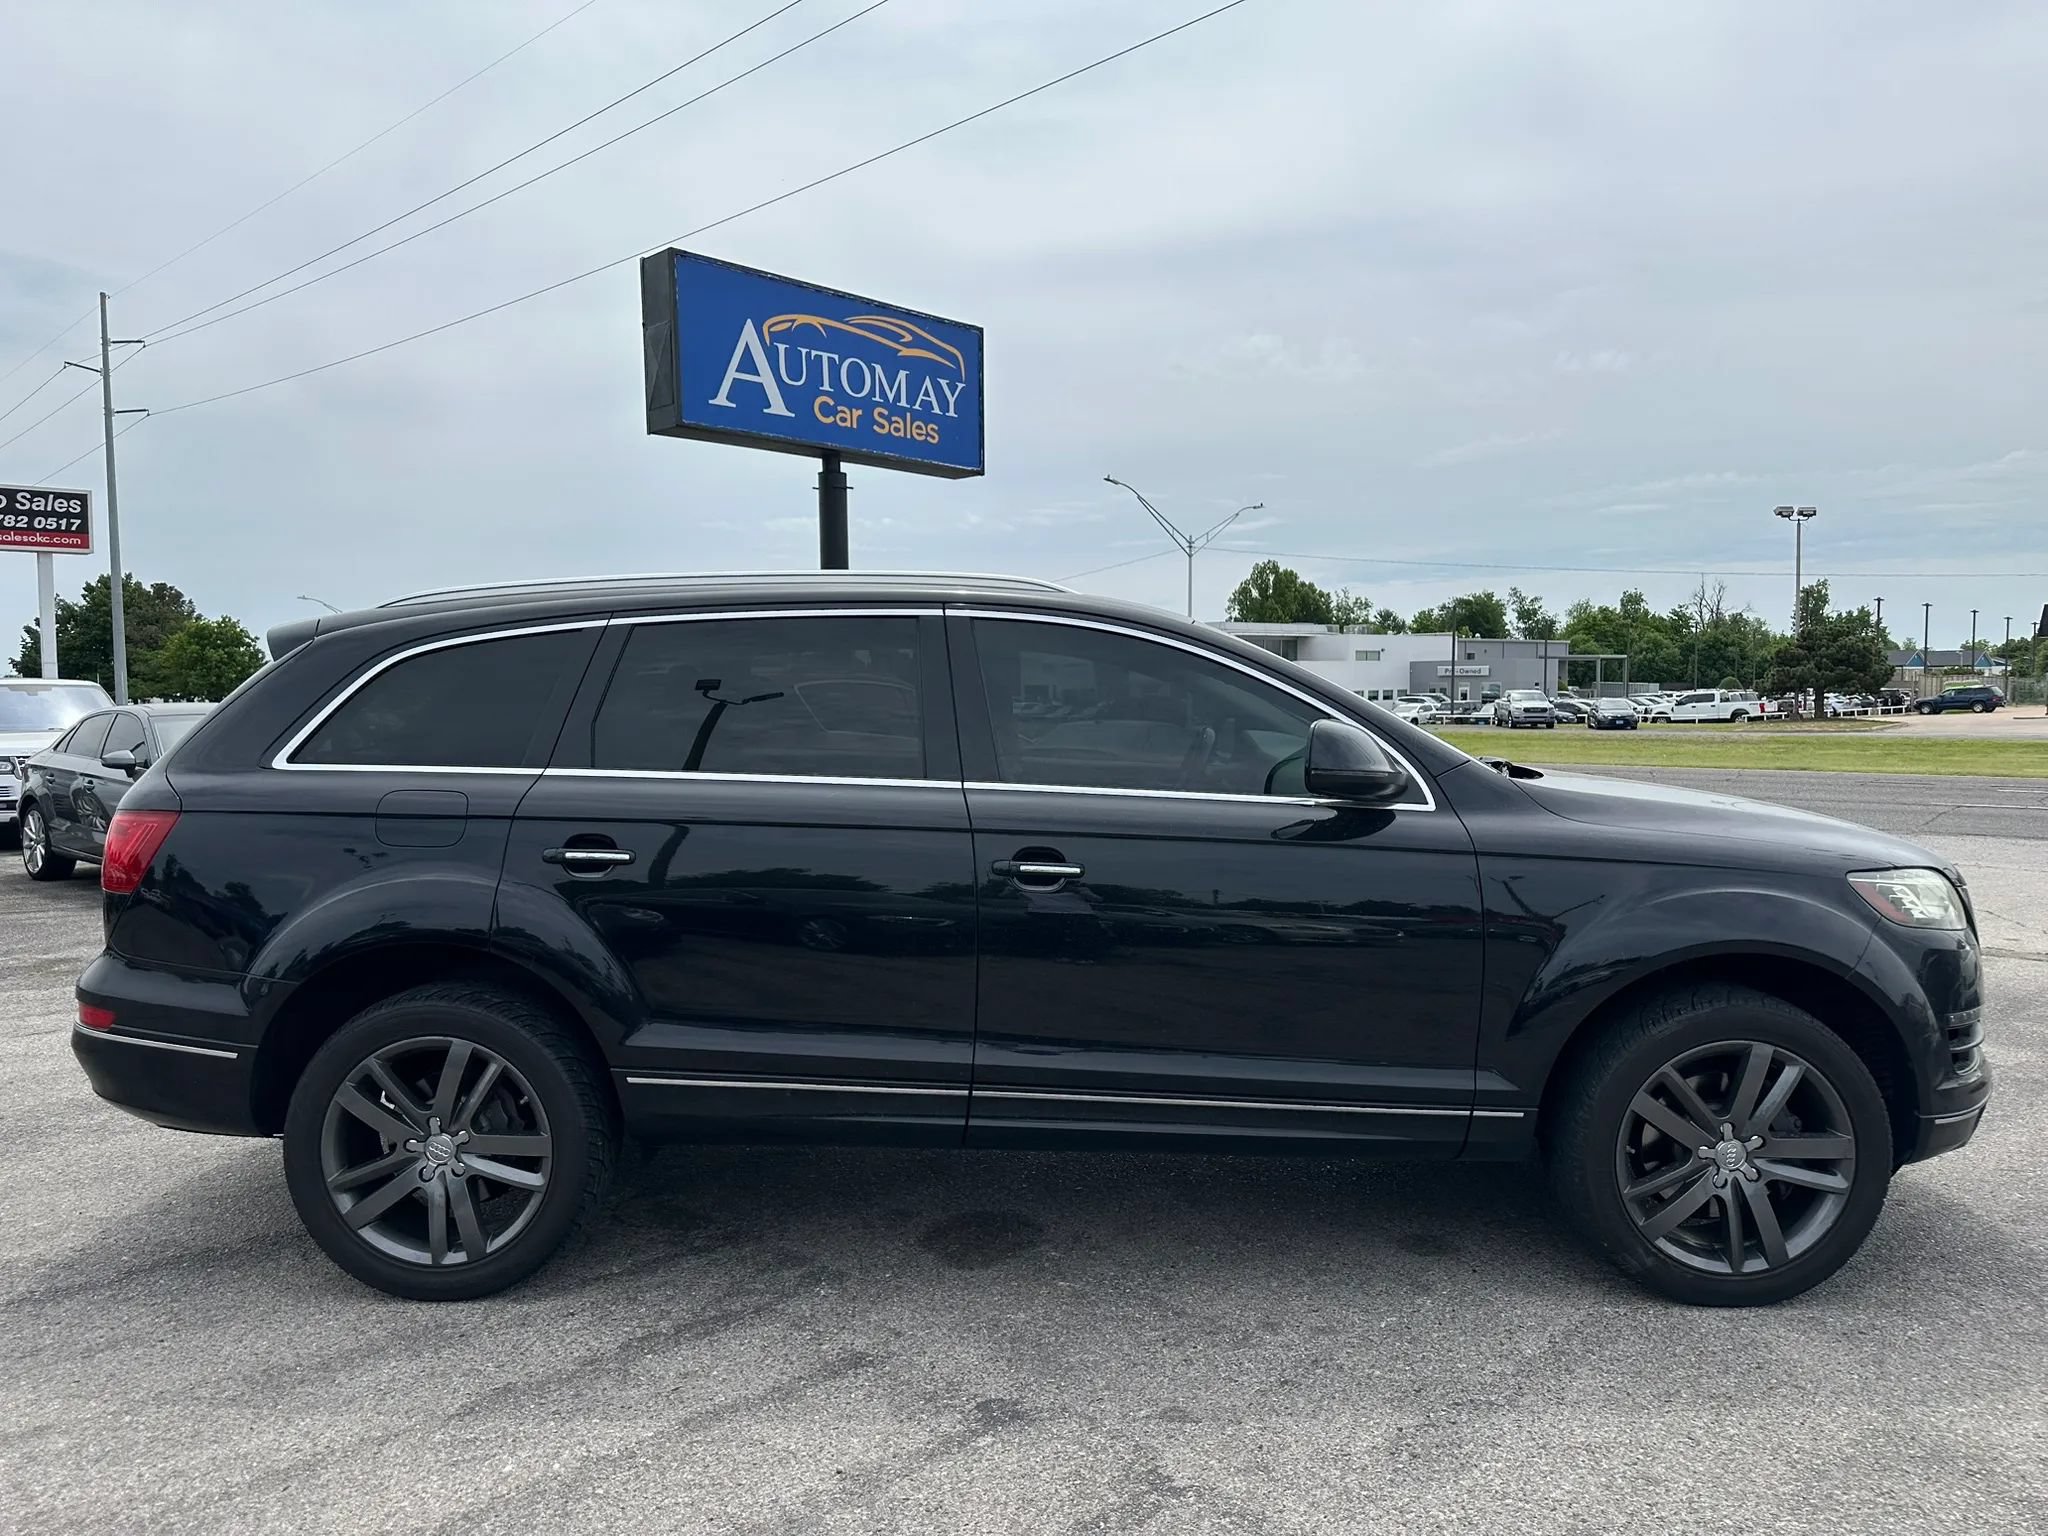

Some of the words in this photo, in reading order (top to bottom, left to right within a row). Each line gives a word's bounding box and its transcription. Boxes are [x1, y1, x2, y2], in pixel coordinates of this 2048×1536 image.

[813, 395, 862, 429] Car
[872, 407, 941, 445] Sales
[15, 492, 81, 513] Sales
[33, 516, 81, 531] 0517
[1444, 667, 1482, 675] Pr-Owned
